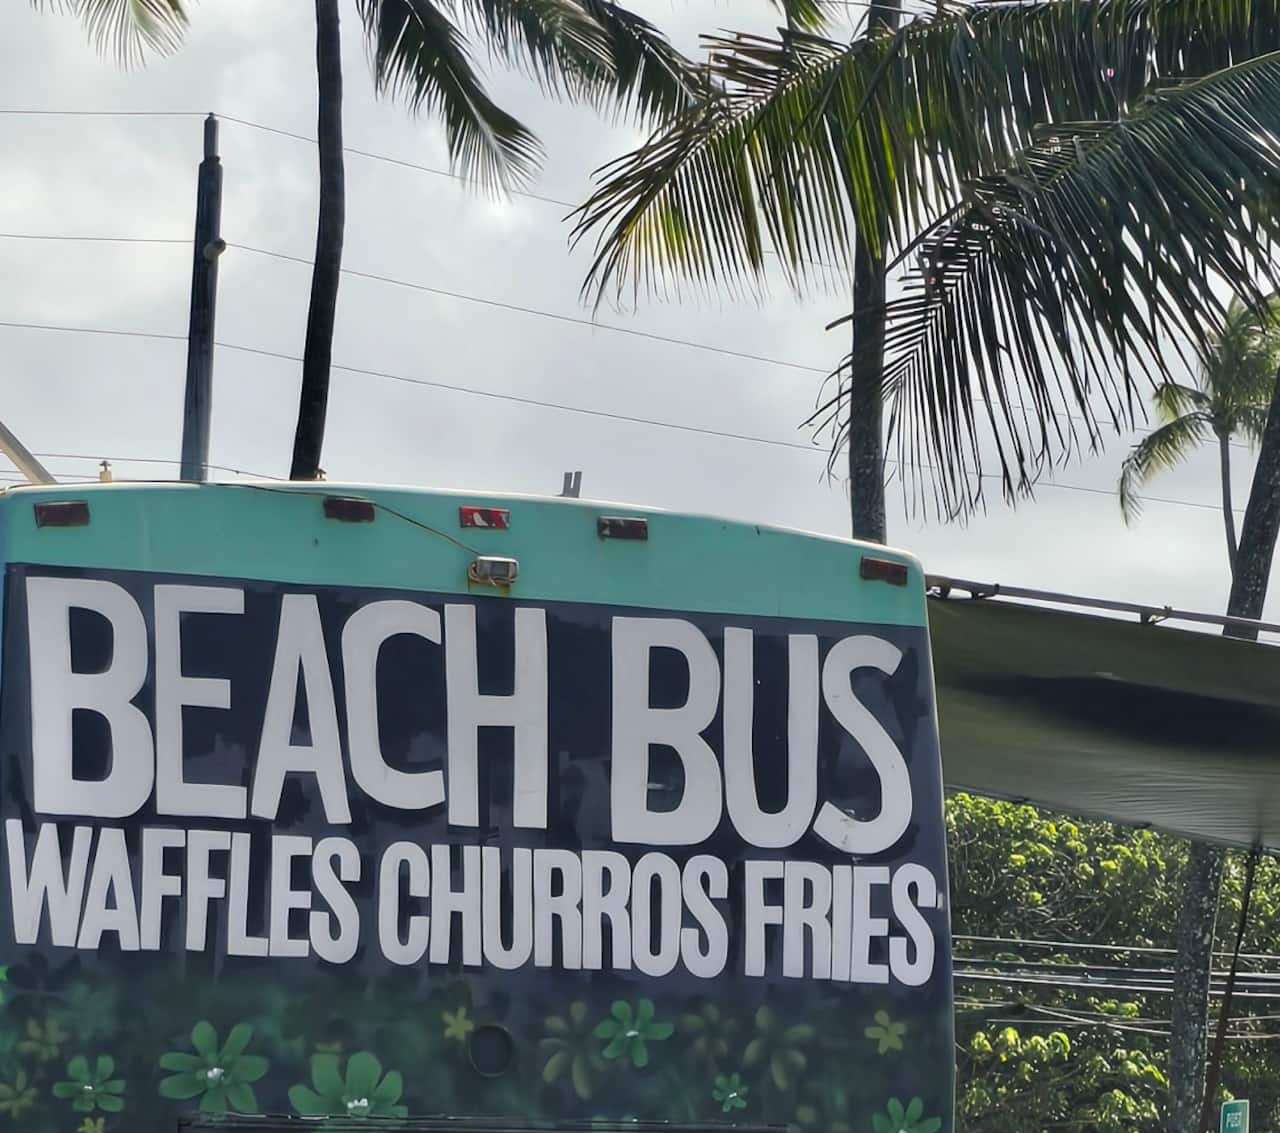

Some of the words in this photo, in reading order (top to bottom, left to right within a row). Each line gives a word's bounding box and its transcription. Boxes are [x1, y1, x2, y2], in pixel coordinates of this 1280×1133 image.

[26, 577, 548, 828] BEACH
[611, 616, 913, 854] BUS
[6, 819, 360, 965] WAFFLES
[379, 841, 728, 977] CHURROS
[744, 859, 937, 985] FRIES
